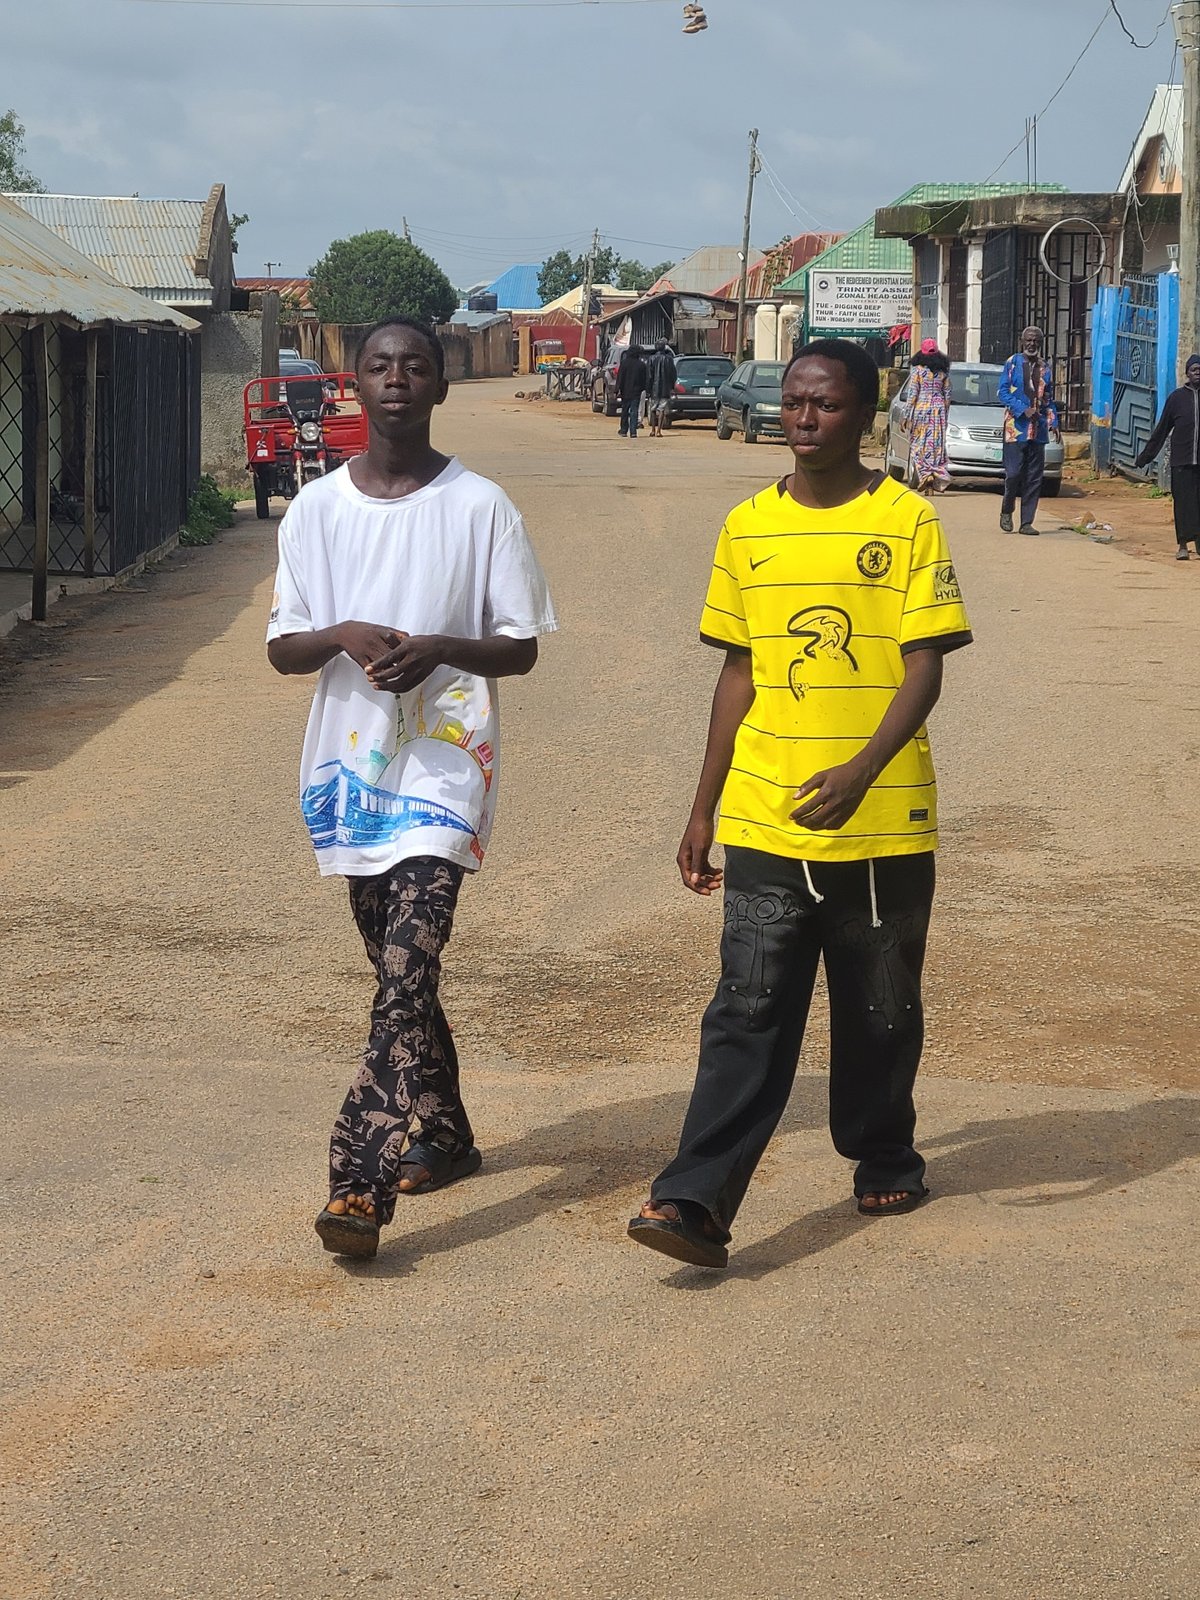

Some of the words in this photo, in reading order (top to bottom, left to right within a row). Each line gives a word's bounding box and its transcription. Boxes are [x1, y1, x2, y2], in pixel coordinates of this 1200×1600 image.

[835, 276, 845, 285] THE
[846, 276, 872, 285] REDEEMED
[872, 277, 899, 285] CHRISTIAN
[935, 588, 960, 601] HYU
